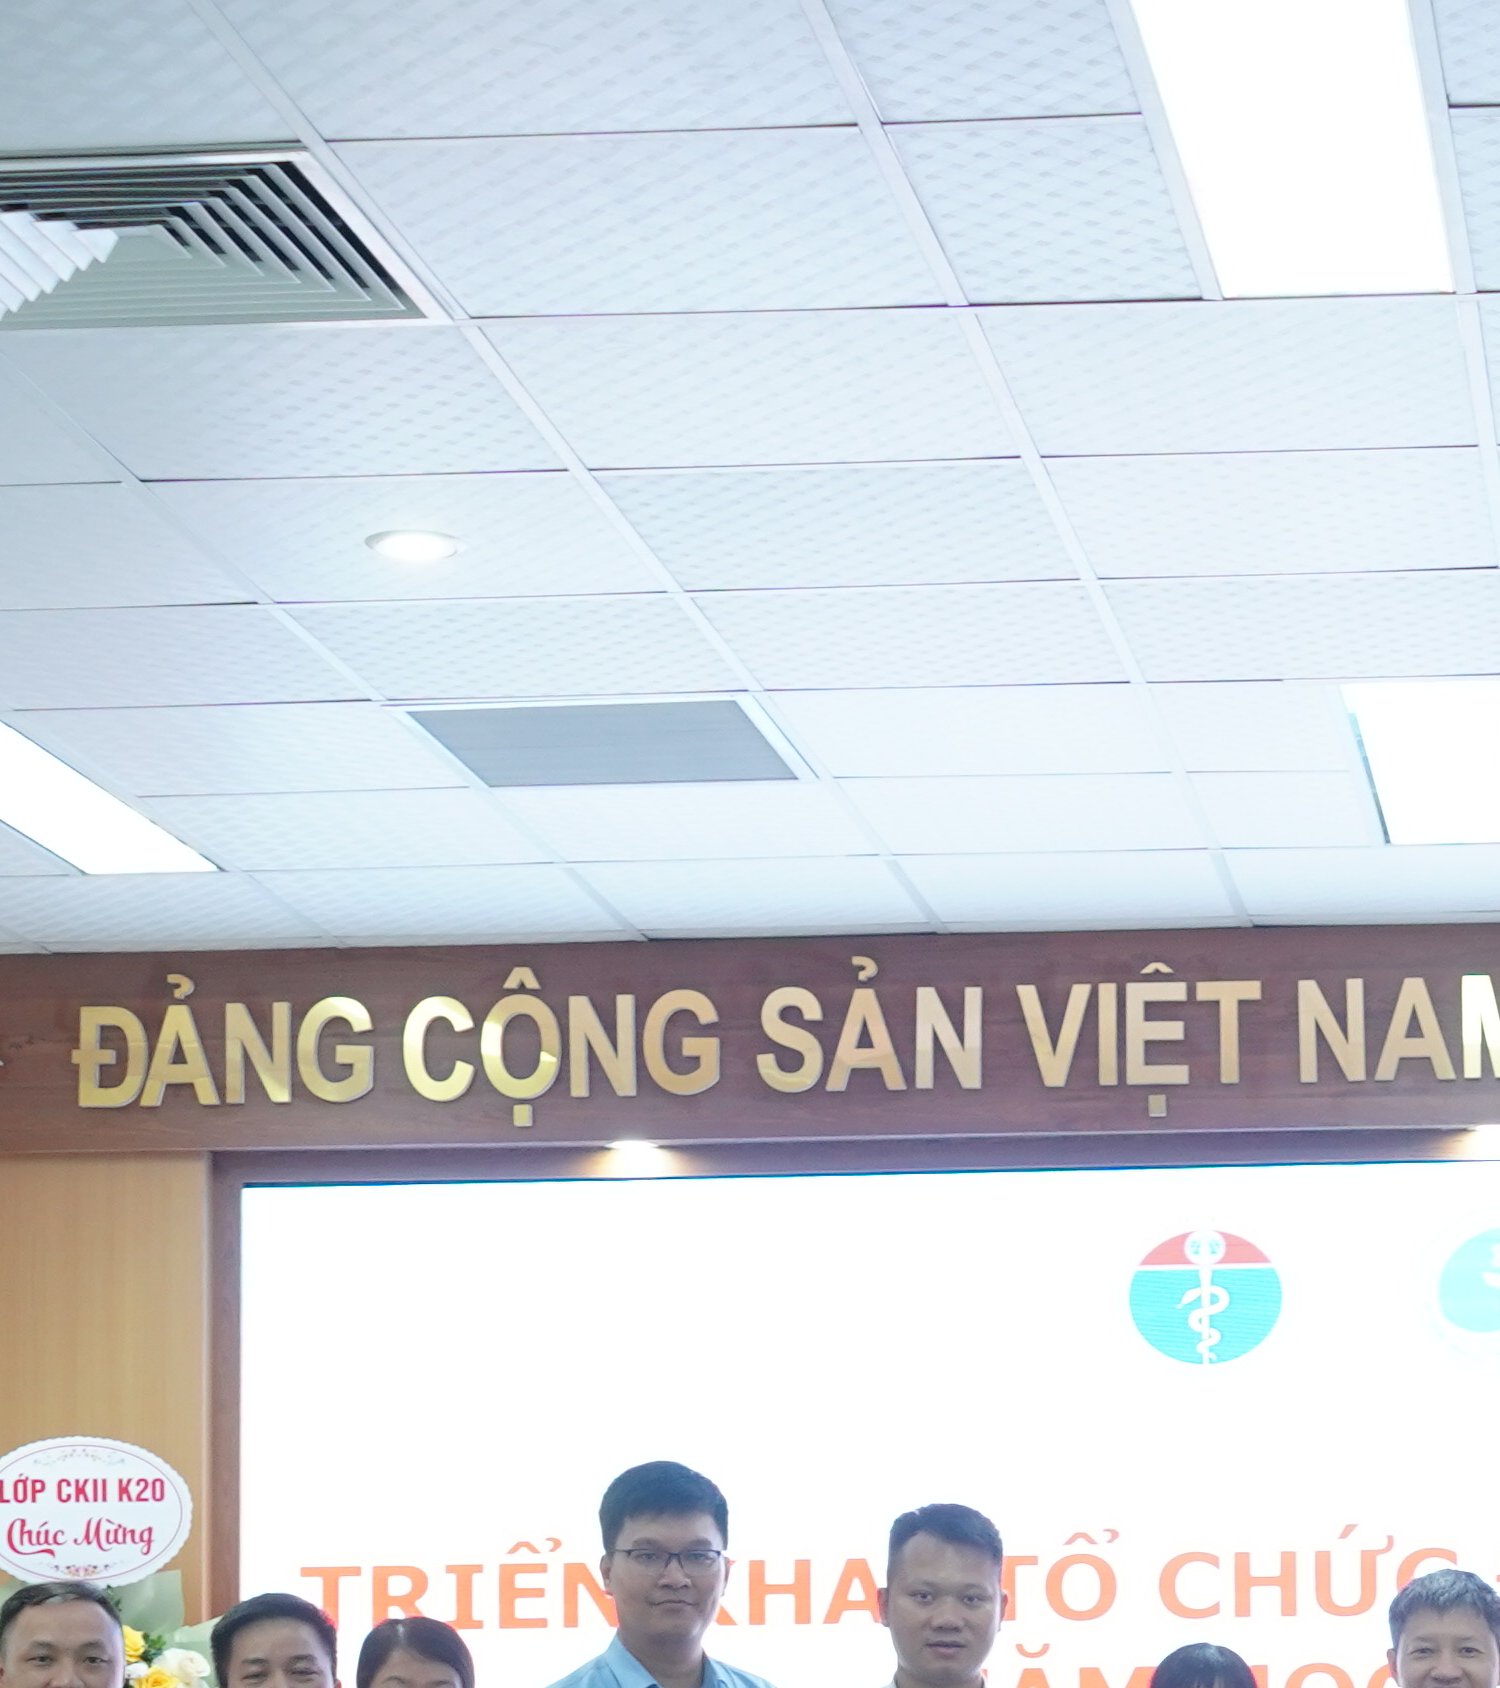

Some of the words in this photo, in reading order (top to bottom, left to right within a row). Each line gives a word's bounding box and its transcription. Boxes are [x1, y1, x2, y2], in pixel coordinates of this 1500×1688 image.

[72, 973, 374, 1109] ĐẢNG
[402, 966, 721, 1128] CỘNG
[755, 955, 984, 1094] SẢN
[1016, 961, 1263, 1118] VIỆT
[57, 1478, 108, 1503] CKII
[118, 1477, 165, 1503] K20
[7, 1518, 67, 1558] Chúc
[73, 1516, 154, 1555] Mừng
